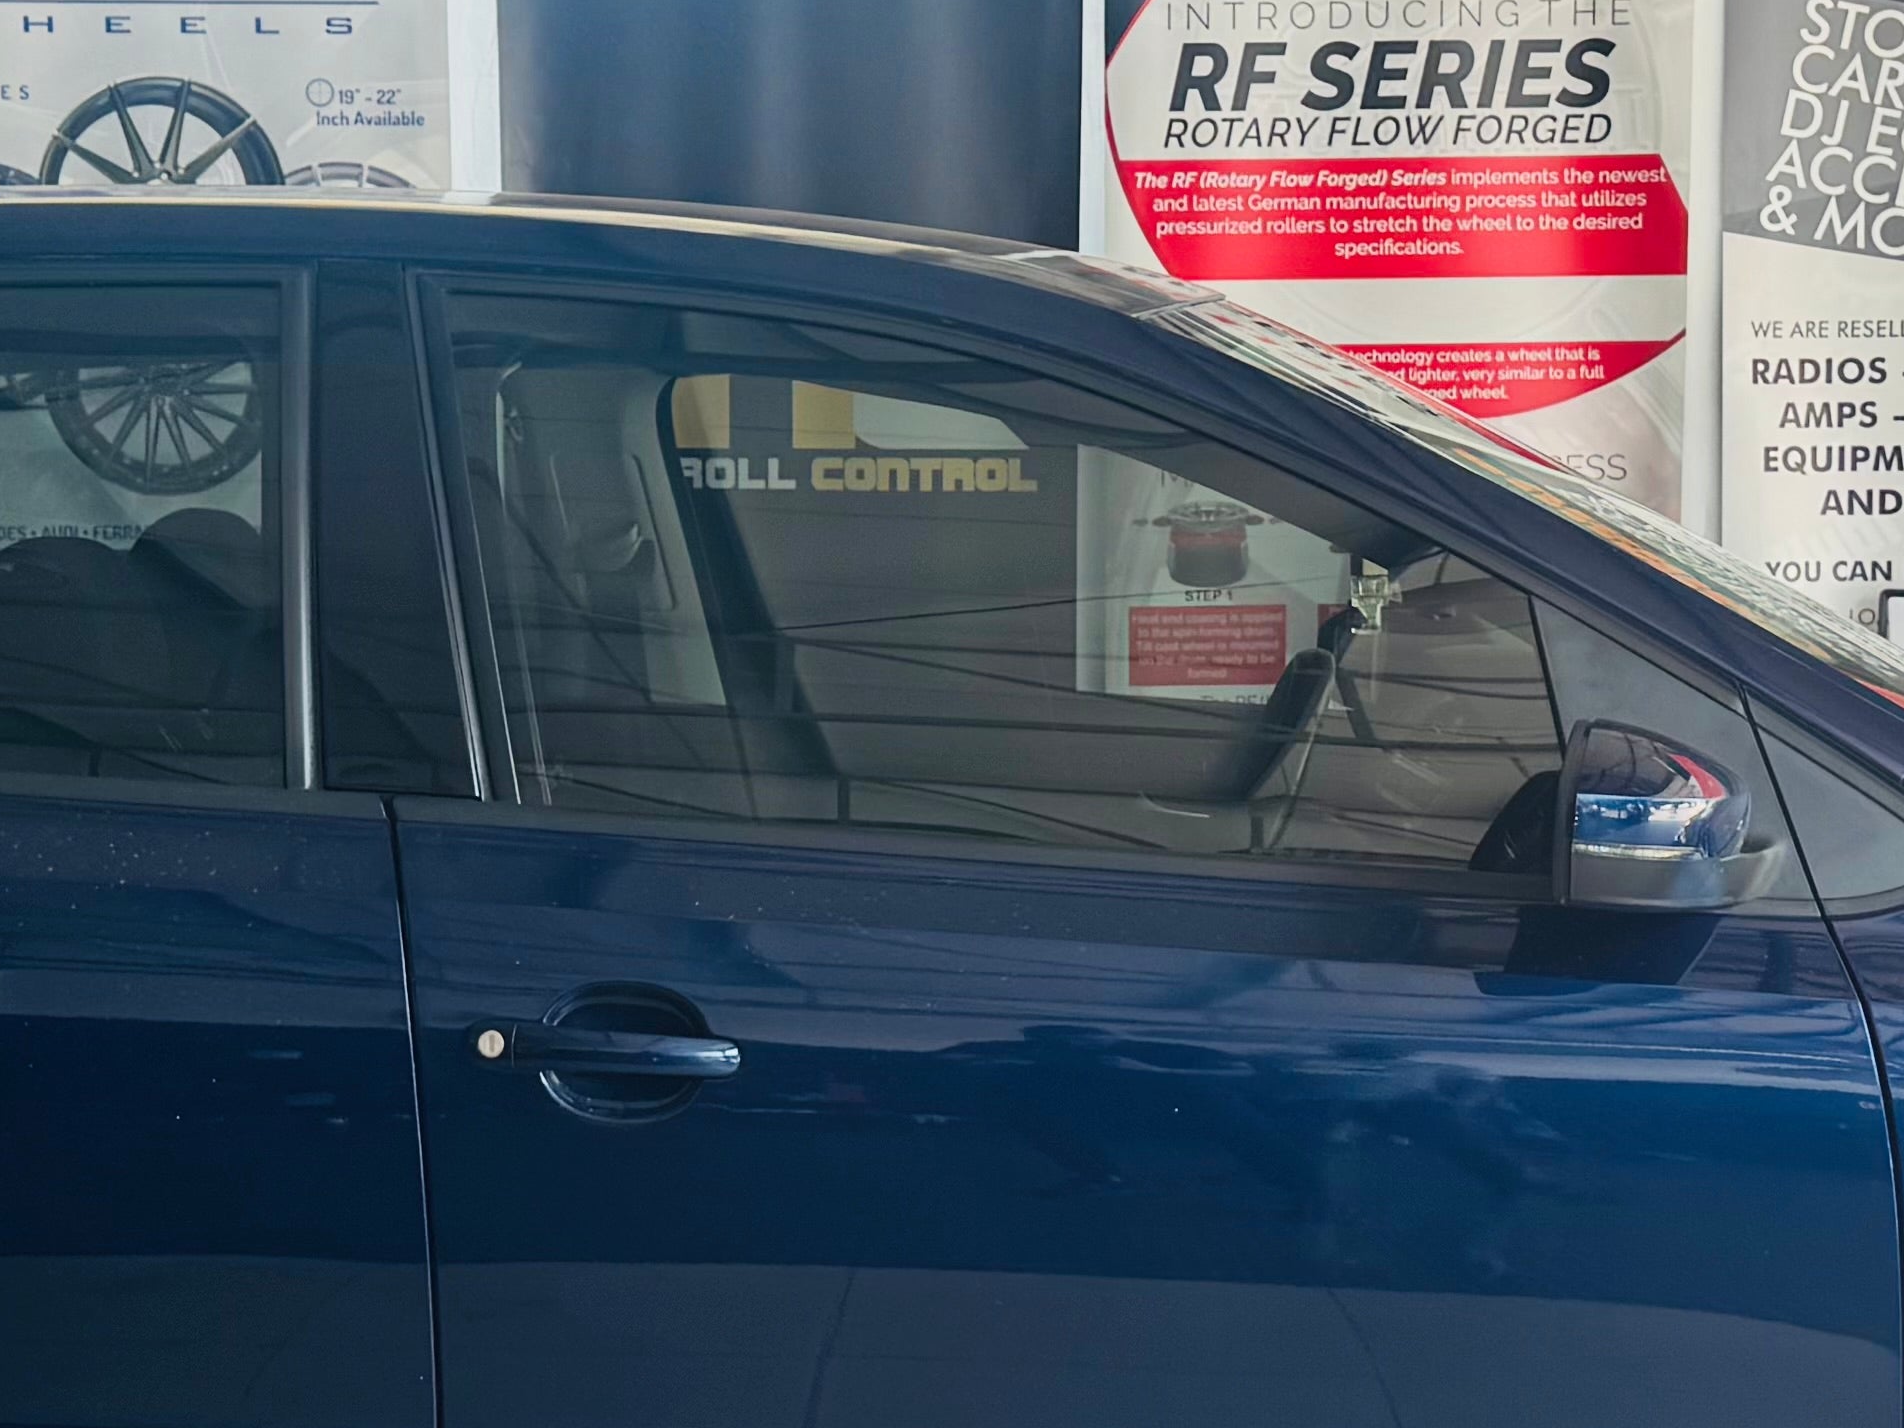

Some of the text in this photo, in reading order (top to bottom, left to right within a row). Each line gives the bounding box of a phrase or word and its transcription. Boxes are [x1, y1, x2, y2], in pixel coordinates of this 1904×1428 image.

[1168, 37, 1618, 112] RF SERIES
[316, 111, 425, 126] Inch Available
[1780, 89, 1852, 145] DJ
[1163, 114, 1613, 149] ROTARY FLOW FORGED
[1135, 166, 1667, 191] The (Rotary Flow Forged) Series implements newest
[1192, 190, 1647, 212] latest German manufacturing process utilizes
[1759, 183, 1799, 236] &
[1156, 212, 1643, 238] pressurized rollers stretch desired
[1335, 238, 1464, 259] specifications.
[1750, 319, 1784, 340] WE
[1787, 319, 1830, 339] ARE
[1750, 357, 1889, 385] RADIOS
[1778, 400, 1880, 430] AMPS
[810, 457, 1038, 492] CONTROL
[1820, 488, 1904, 517] AND
[1765, 560, 1823, 583] YOU
[1831, 559, 1893, 583] CAN
[1184, 590, 1222, 602] STEP
